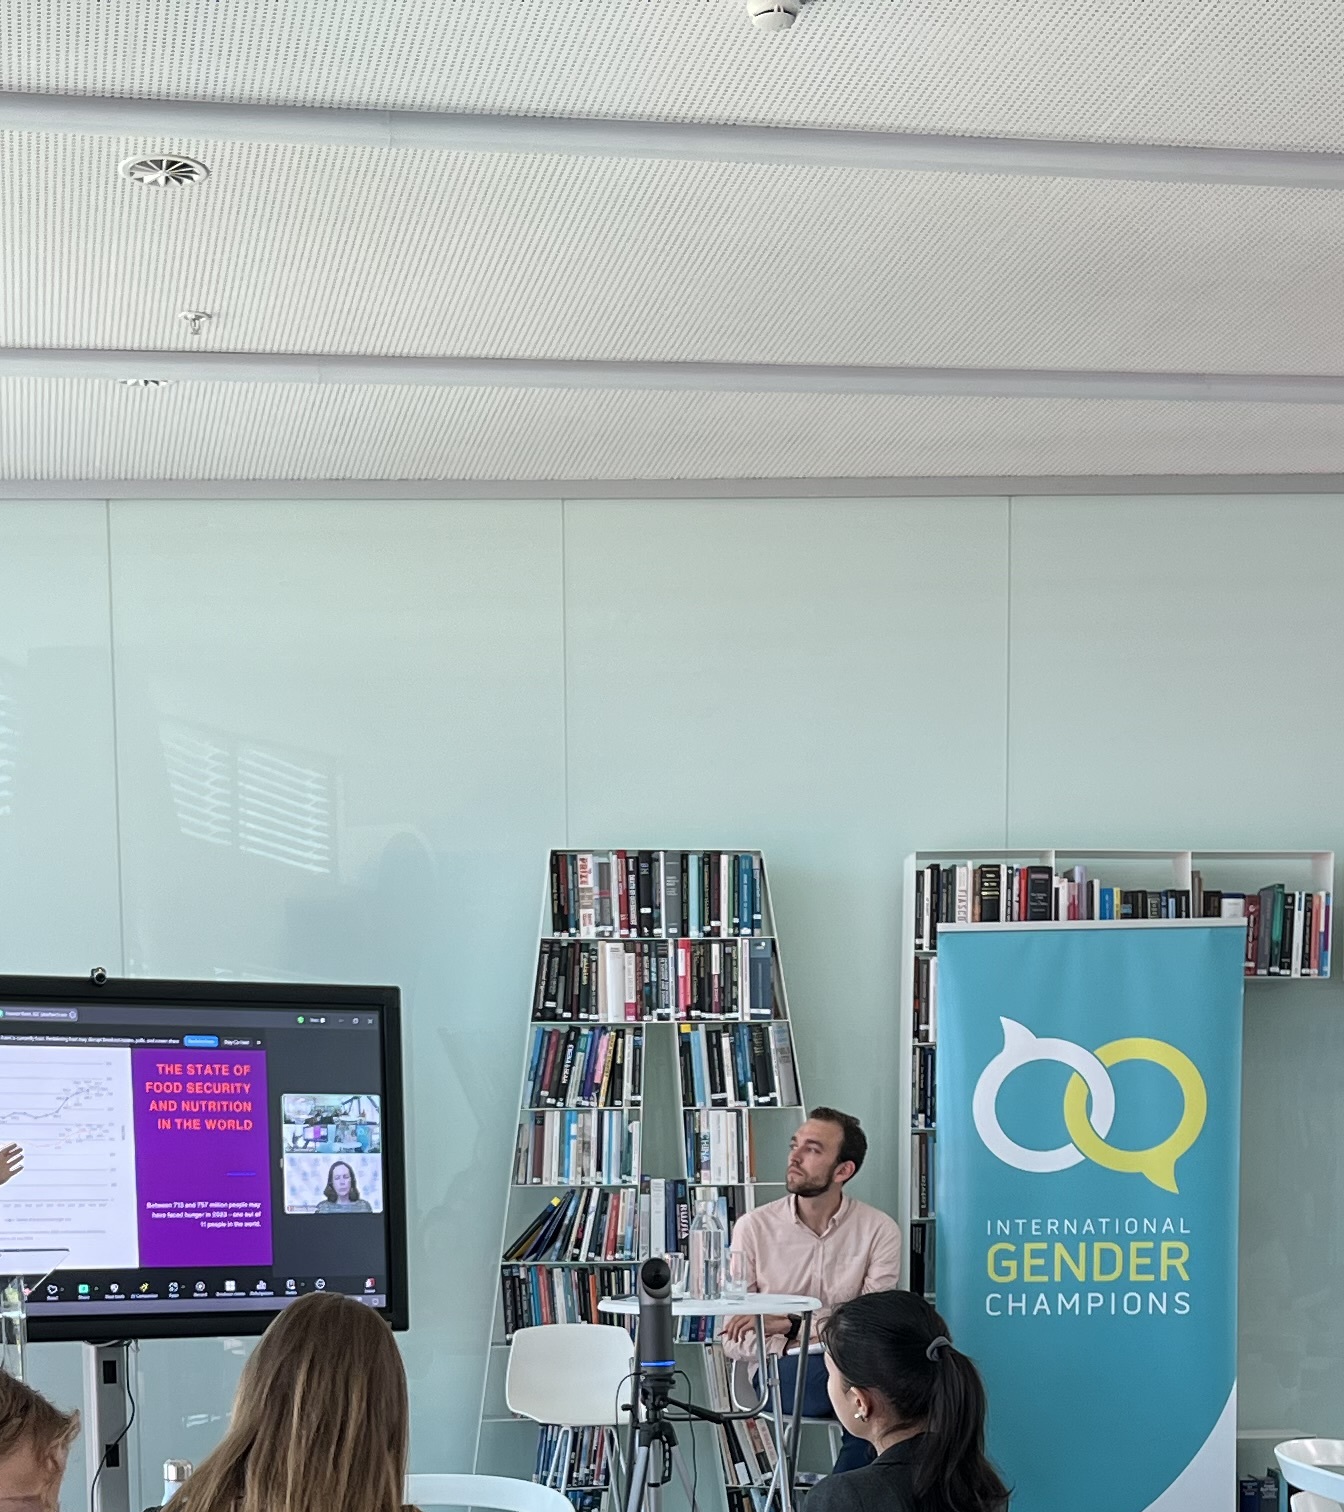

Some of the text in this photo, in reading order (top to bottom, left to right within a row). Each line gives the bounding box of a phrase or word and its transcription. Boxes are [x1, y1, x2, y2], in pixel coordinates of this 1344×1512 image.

[156, 1063, 251, 1076] THE STATE OF
[145, 1081, 251, 1094] FOOD SECURITY
[149, 1100, 252, 1113] AND NUTRITION
[157, 1118, 253, 1131] IN THE WORLD
[987, 1217, 1191, 1236] INTERNATIONAL
[987, 1240, 1191, 1283] GENDER
[985, 1291, 1191, 1316] CHAMPIONS
